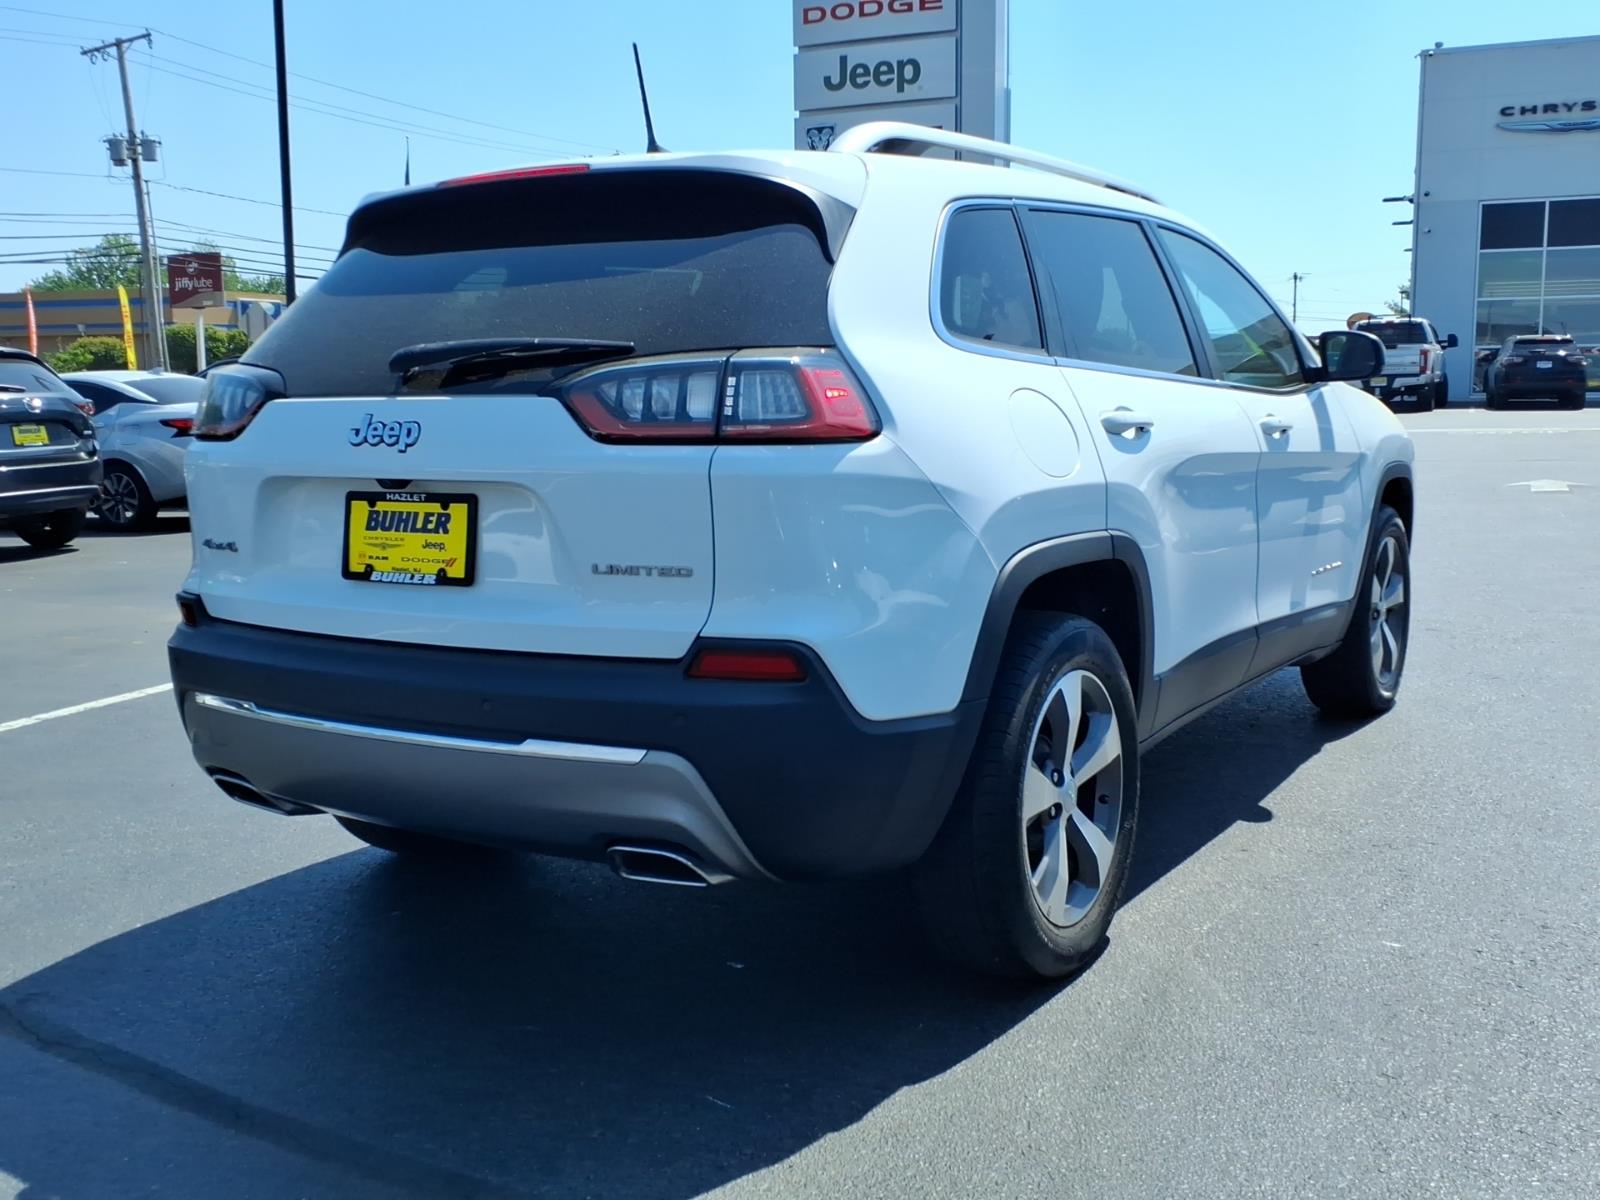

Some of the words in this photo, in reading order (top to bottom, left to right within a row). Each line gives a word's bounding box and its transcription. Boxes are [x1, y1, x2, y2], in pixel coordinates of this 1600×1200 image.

[803, 0, 943, 24] DODGE
[823, 55, 921, 93] Jeep
[349, 413, 421, 453] Jeep
[386, 493, 426, 501] HAZLET
[365, 509, 451, 534] BUHLER
[422, 539, 446, 552] Jeep
[370, 571, 437, 584] BUHLER
[592, 563, 693, 577] LIMITED
